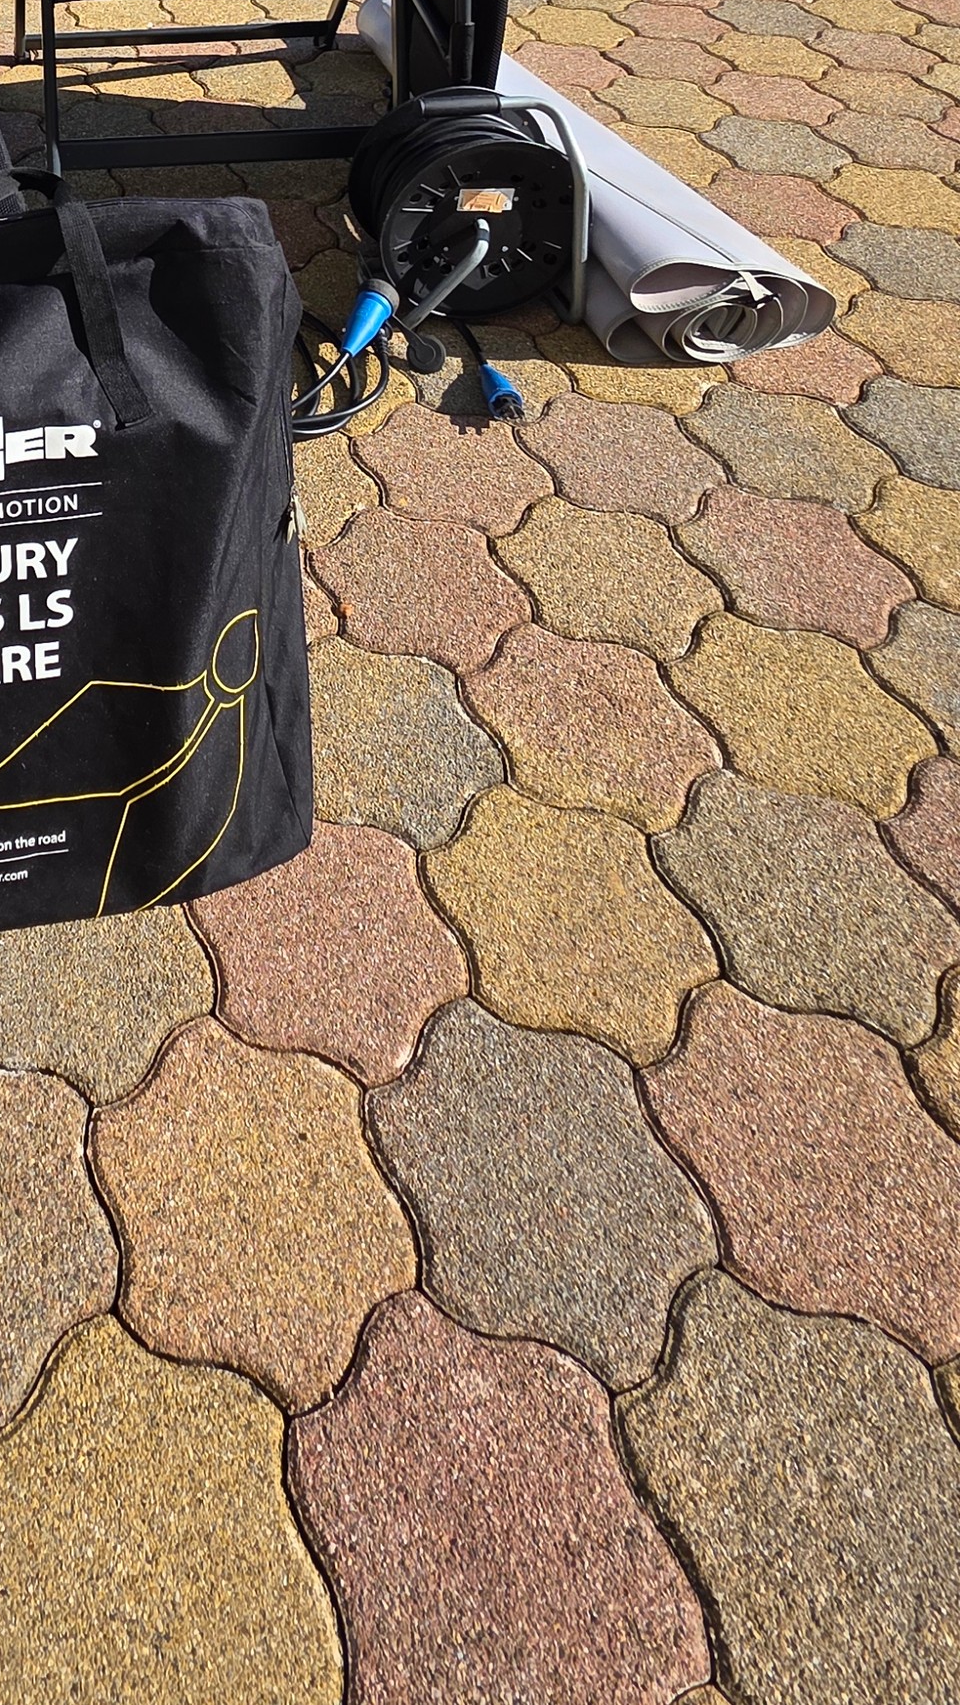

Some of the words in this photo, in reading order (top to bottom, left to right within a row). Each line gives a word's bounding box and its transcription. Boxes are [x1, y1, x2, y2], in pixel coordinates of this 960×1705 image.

[18, 588, 74, 631] LS
[14, 835, 36, 850] the
[37, 829, 66, 846] road
